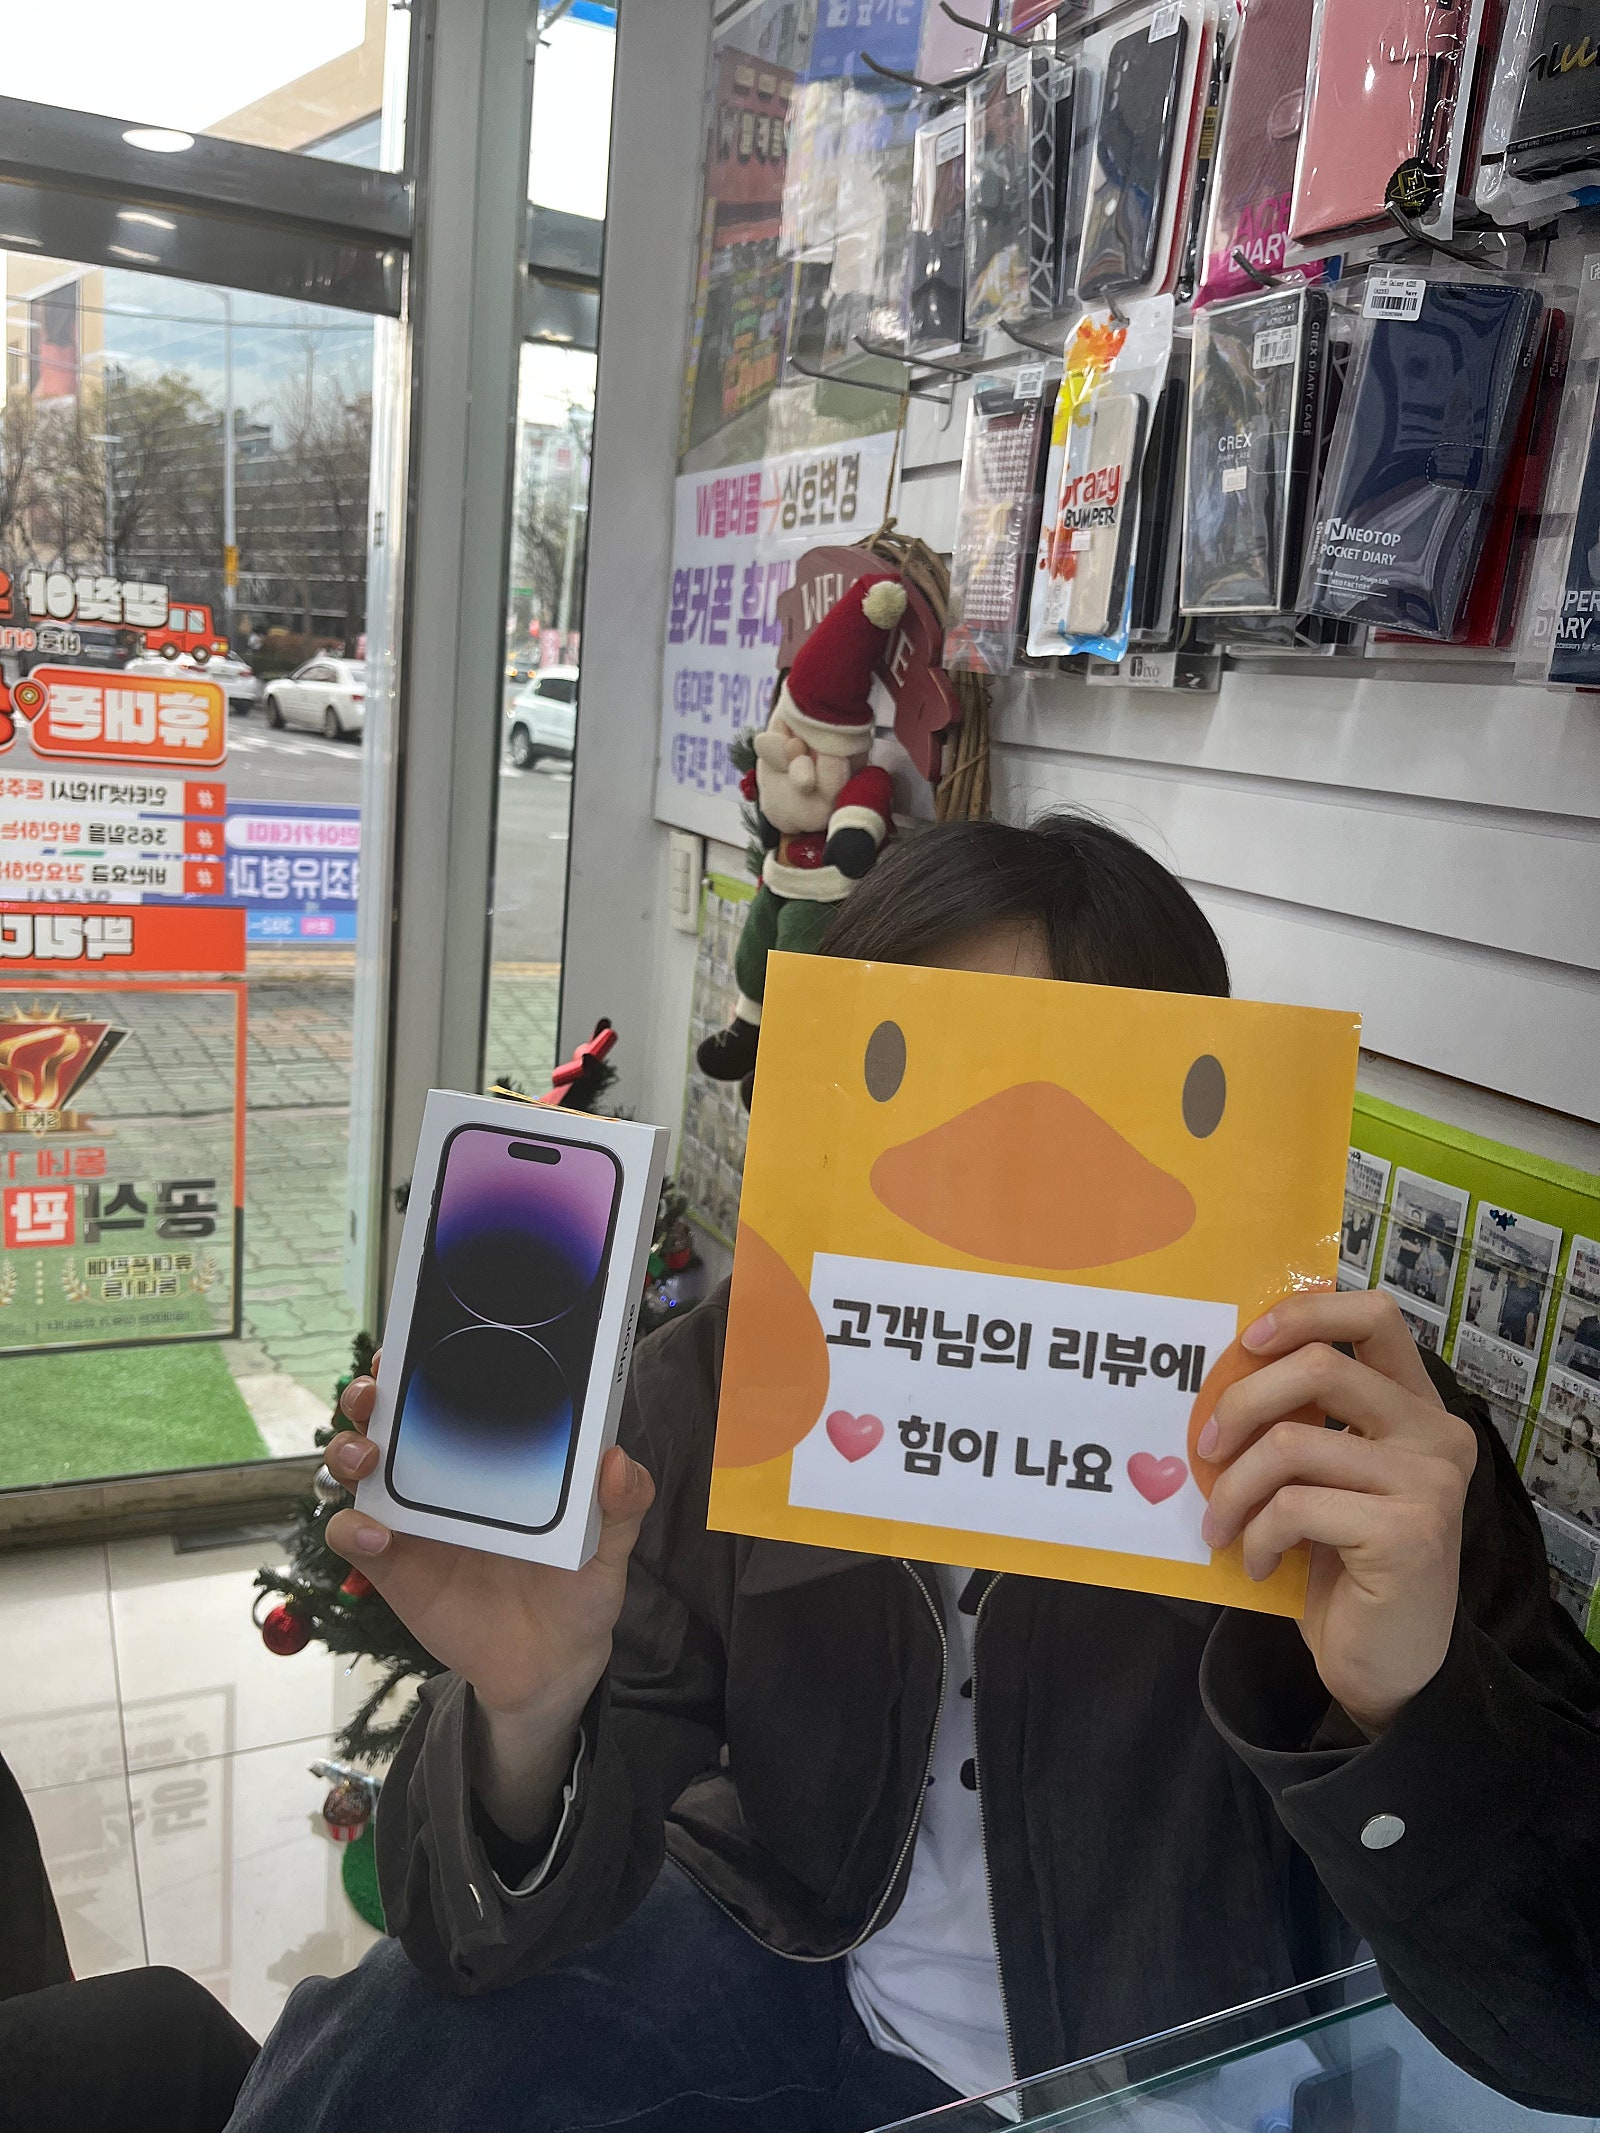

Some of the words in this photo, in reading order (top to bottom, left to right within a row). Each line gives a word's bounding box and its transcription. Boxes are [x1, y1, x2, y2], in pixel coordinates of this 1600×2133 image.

[1232, 191, 1293, 246] ACE
[1228, 231, 1295, 273] DIARY
[1304, 361, 1319, 399] DIARY
[1301, 403, 1314, 438] CASE
[1217, 431, 1253, 452] CREX
[781, 452, 861, 531] 상호변경
[1063, 506, 1116, 528] BUMPER
[1320, 543, 1361, 561] POCKET
[1362, 550, 1397, 567] DIARY
[1345, 526, 1401, 547] NEOTOP
[1534, 616, 1593, 640] DIARY
[616, 1302, 637, 1385] iPhone
[825, 1298, 1033, 1371] 고객님의
[1048, 1326, 1207, 1394] 리뷰에
[897, 1414, 1000, 1478] 힘이
[1014, 1436, 1113, 1494] 나요
